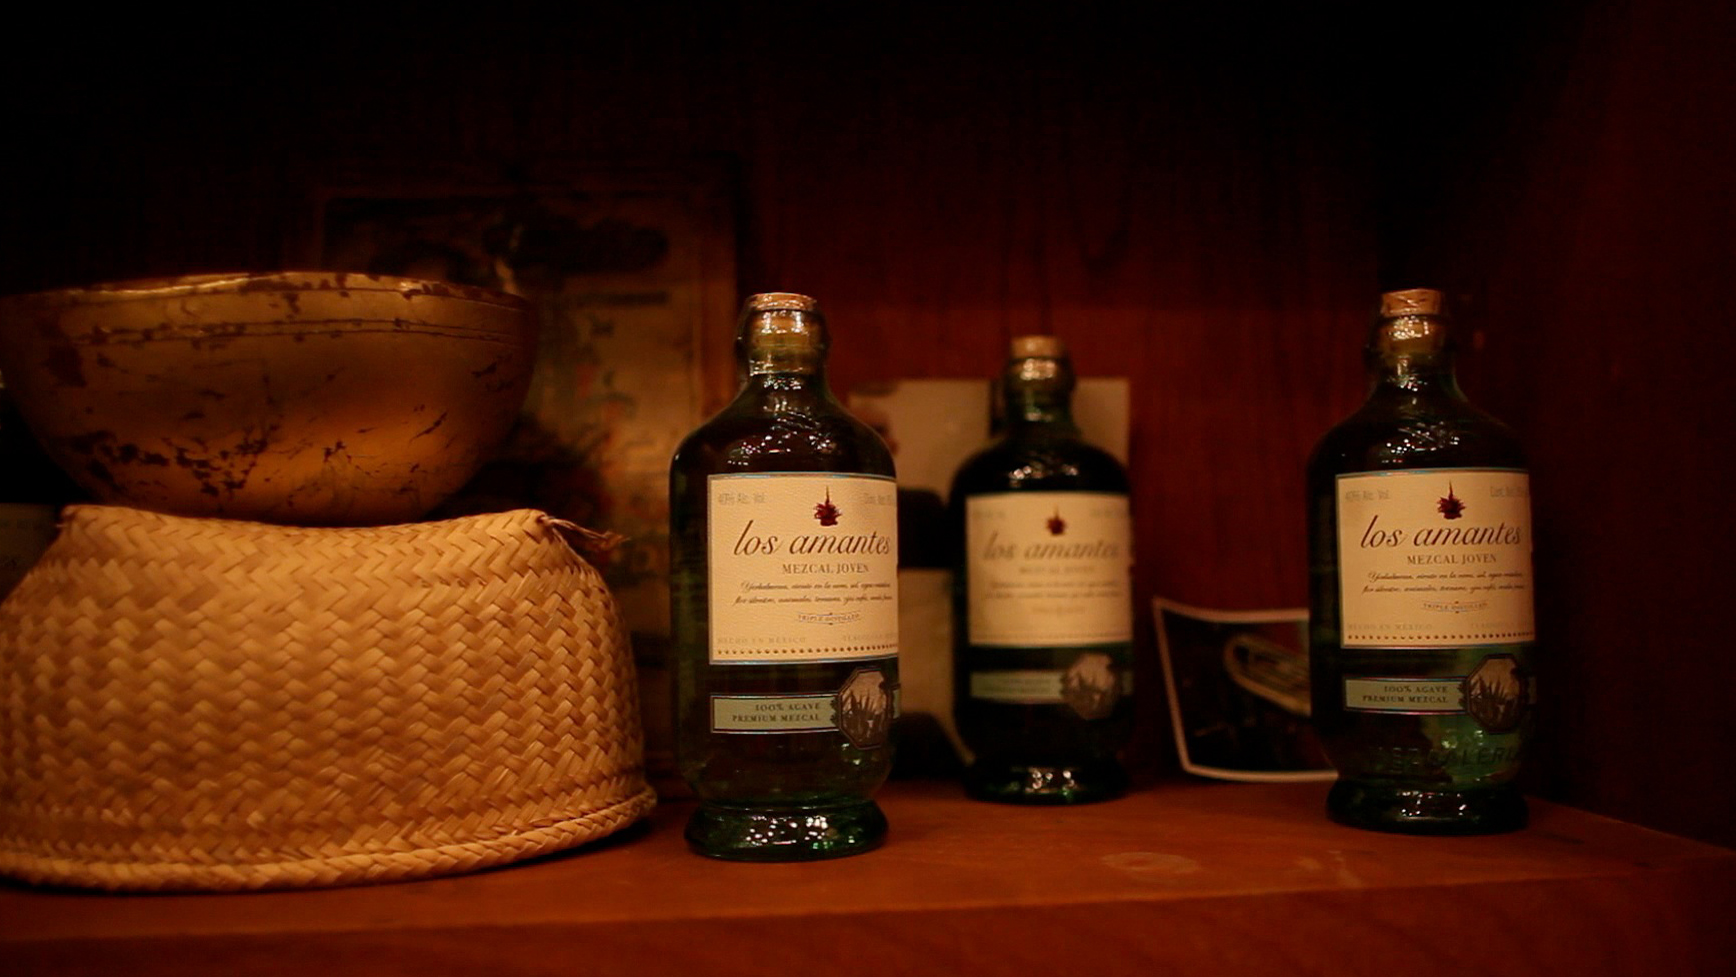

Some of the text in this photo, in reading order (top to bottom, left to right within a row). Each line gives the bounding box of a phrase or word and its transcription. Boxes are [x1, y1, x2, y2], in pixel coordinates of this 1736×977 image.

[1361, 515, 1521, 549] los amantes
[734, 520, 890, 556] los amantes
[1407, 553, 1497, 565] MEZCAL JOVEN
[783, 563, 869, 574] MEZCAL JOVEN
[1384, 685, 1448, 693] 100% AGAVE
[1362, 695, 1448, 703] PREMIUM MEZCAL
[755, 703, 820, 712] 100% AGAVE
[781, 714, 820, 722] MEZCAL
